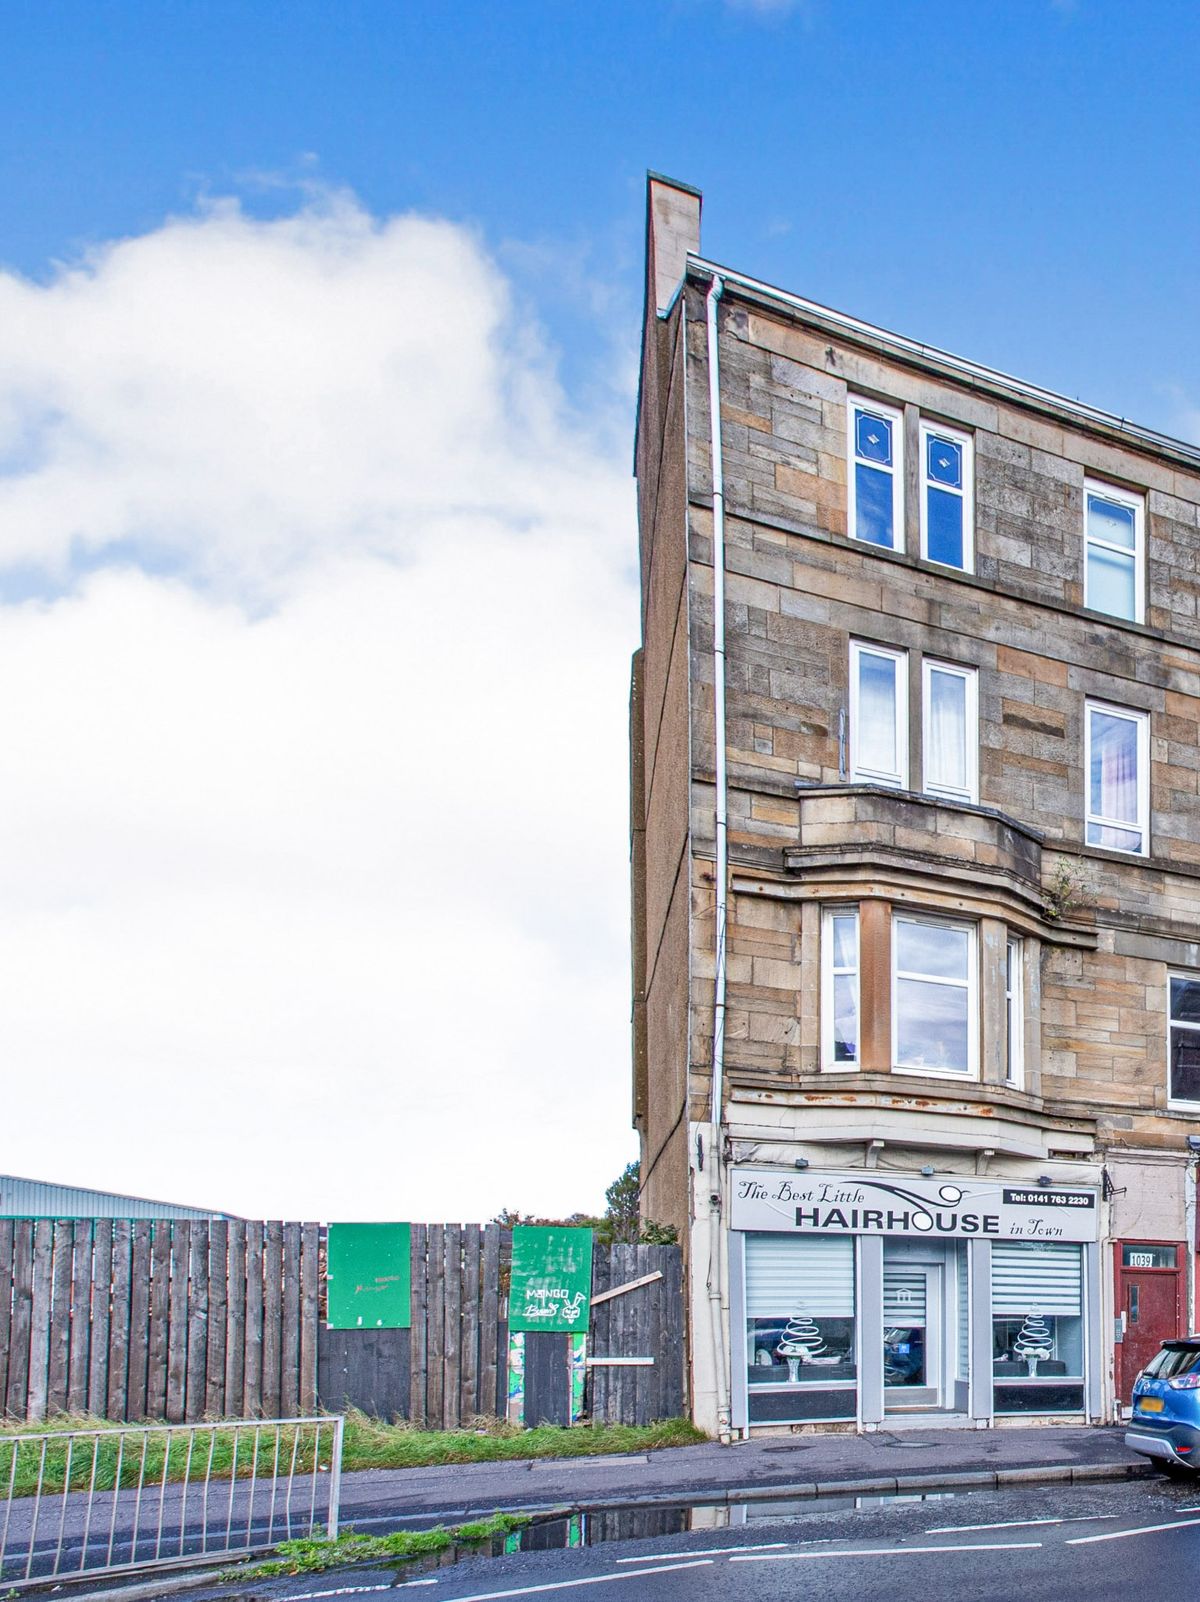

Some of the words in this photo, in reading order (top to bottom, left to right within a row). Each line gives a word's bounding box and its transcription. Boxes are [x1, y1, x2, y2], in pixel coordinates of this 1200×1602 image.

[738, 1181, 768, 1200] The
[772, 1181, 814, 1202] Best
[817, 1183, 864, 1204] Little
[1011, 1193, 1026, 1202] Tel:
[1028, 1195, 1048, 1203] 0141
[1050, 1196, 1067, 1204] 763
[1068, 1197, 1088, 1205] 2230
[795, 1207, 999, 1233] HAIRHOUSE
[1009, 1223, 1023, 1235] in
[1027, 1219, 1063, 1236] Town
[1132, 1255, 1150, 1266] 1039
